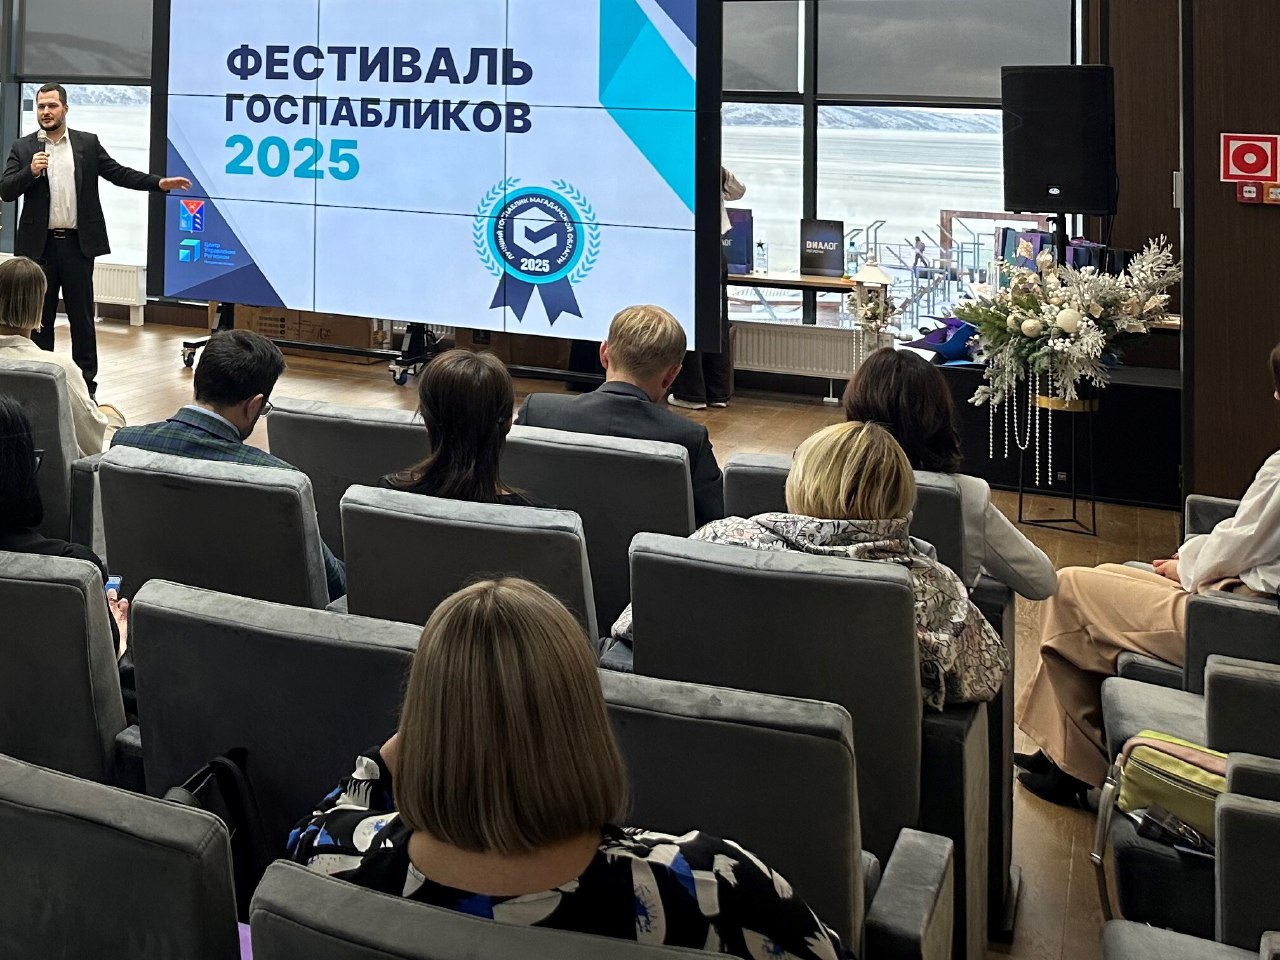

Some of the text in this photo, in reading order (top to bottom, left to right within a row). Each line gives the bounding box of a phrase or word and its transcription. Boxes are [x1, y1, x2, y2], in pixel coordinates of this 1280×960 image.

[226, 44, 533, 86] ФЕСТИВАЛЬ
[225, 93, 532, 133] ГОСПАБЛИКОВ
[225, 134, 360, 181] 2025
[520, 258, 550, 272] 2025
